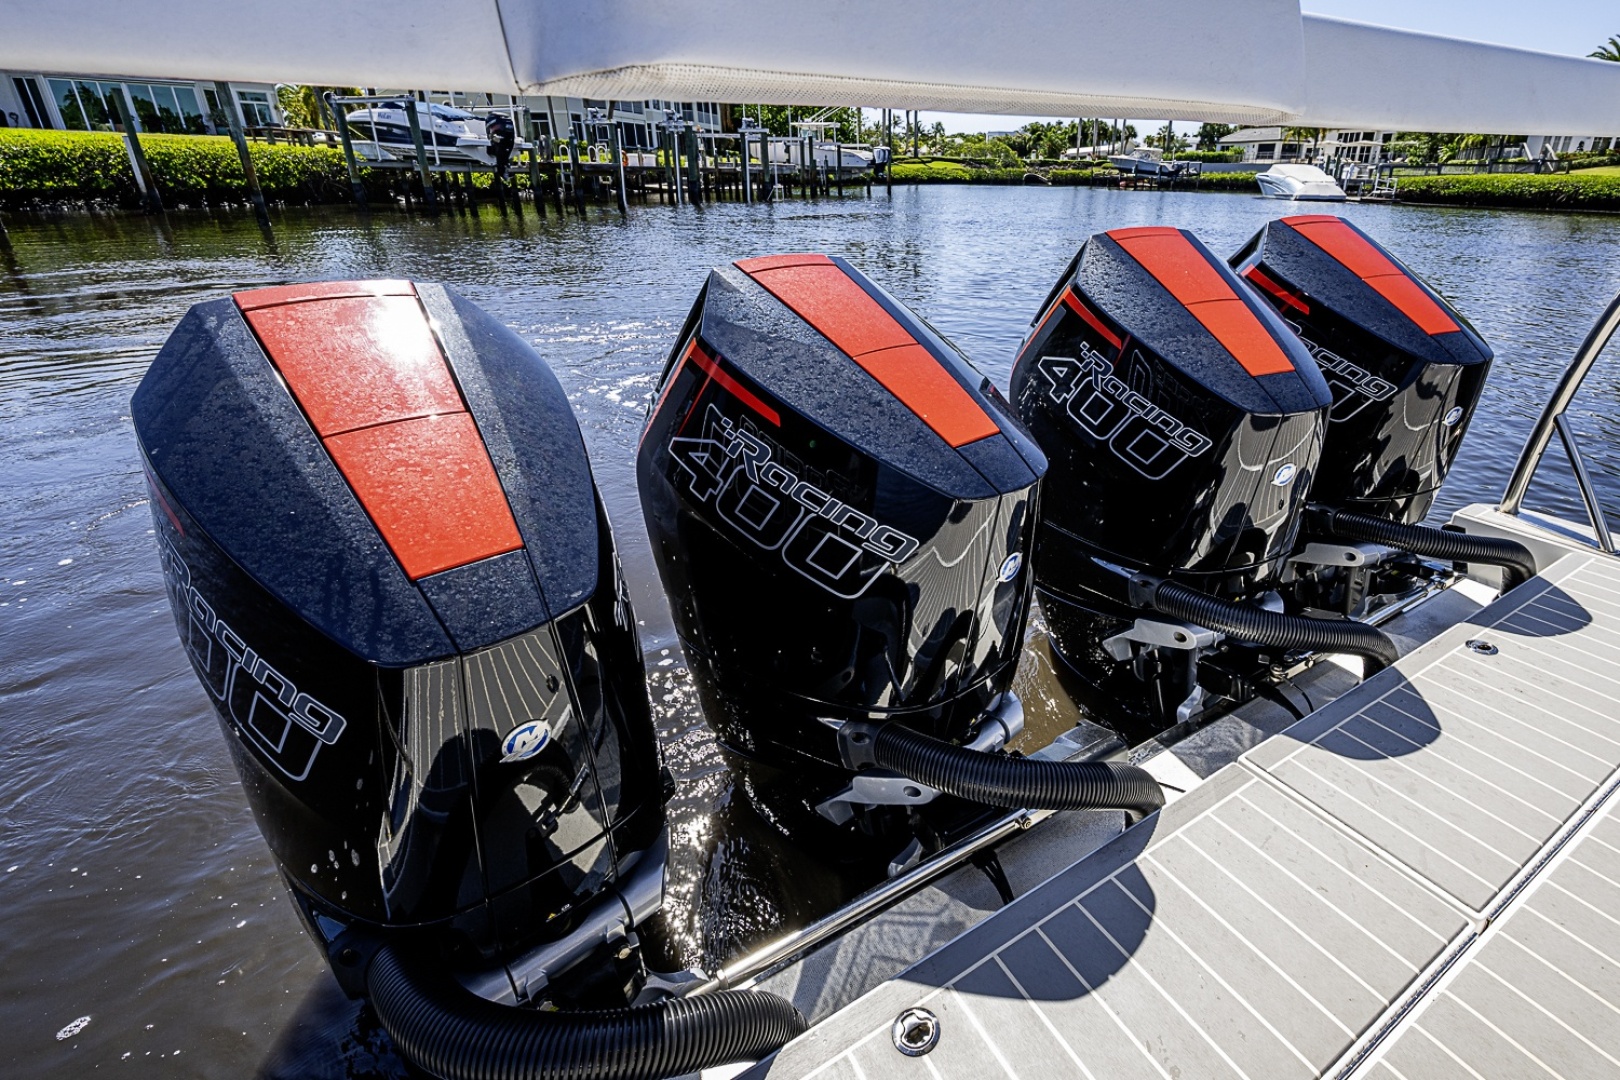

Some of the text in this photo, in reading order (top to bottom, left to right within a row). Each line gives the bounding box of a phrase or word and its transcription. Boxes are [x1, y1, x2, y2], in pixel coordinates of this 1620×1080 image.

[1038, 356, 1189, 481] 400
[1080, 341, 1213, 458] Racing
[668, 436, 891, 599] 400
[721, 416, 920, 564] Racing
